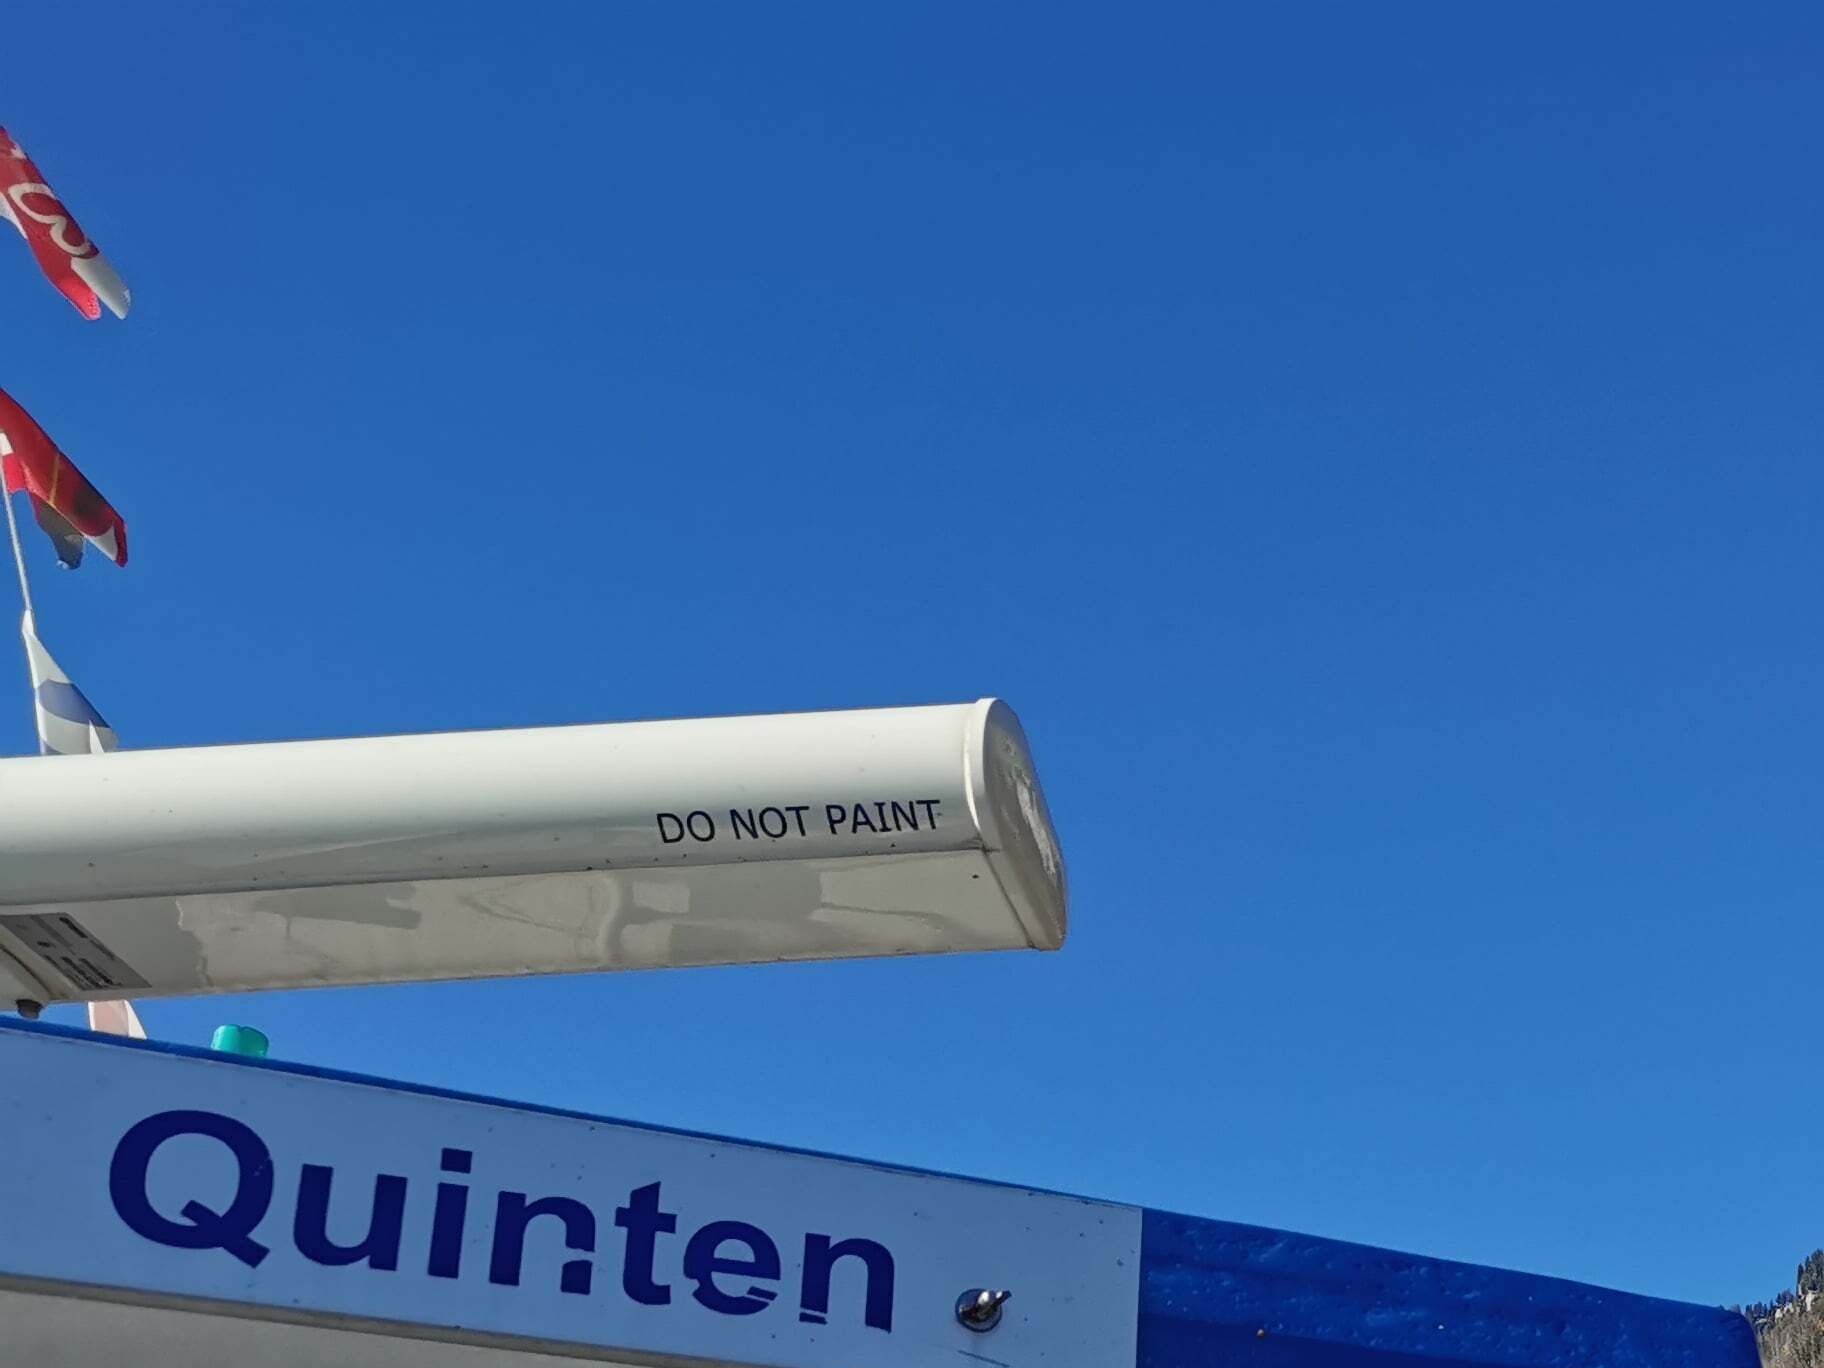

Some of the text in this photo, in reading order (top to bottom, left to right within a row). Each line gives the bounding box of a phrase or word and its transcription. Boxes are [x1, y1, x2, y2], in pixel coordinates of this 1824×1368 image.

[656, 800, 940, 843] DO NOT PAINT
[109, 1110, 895, 1333] Quinten
